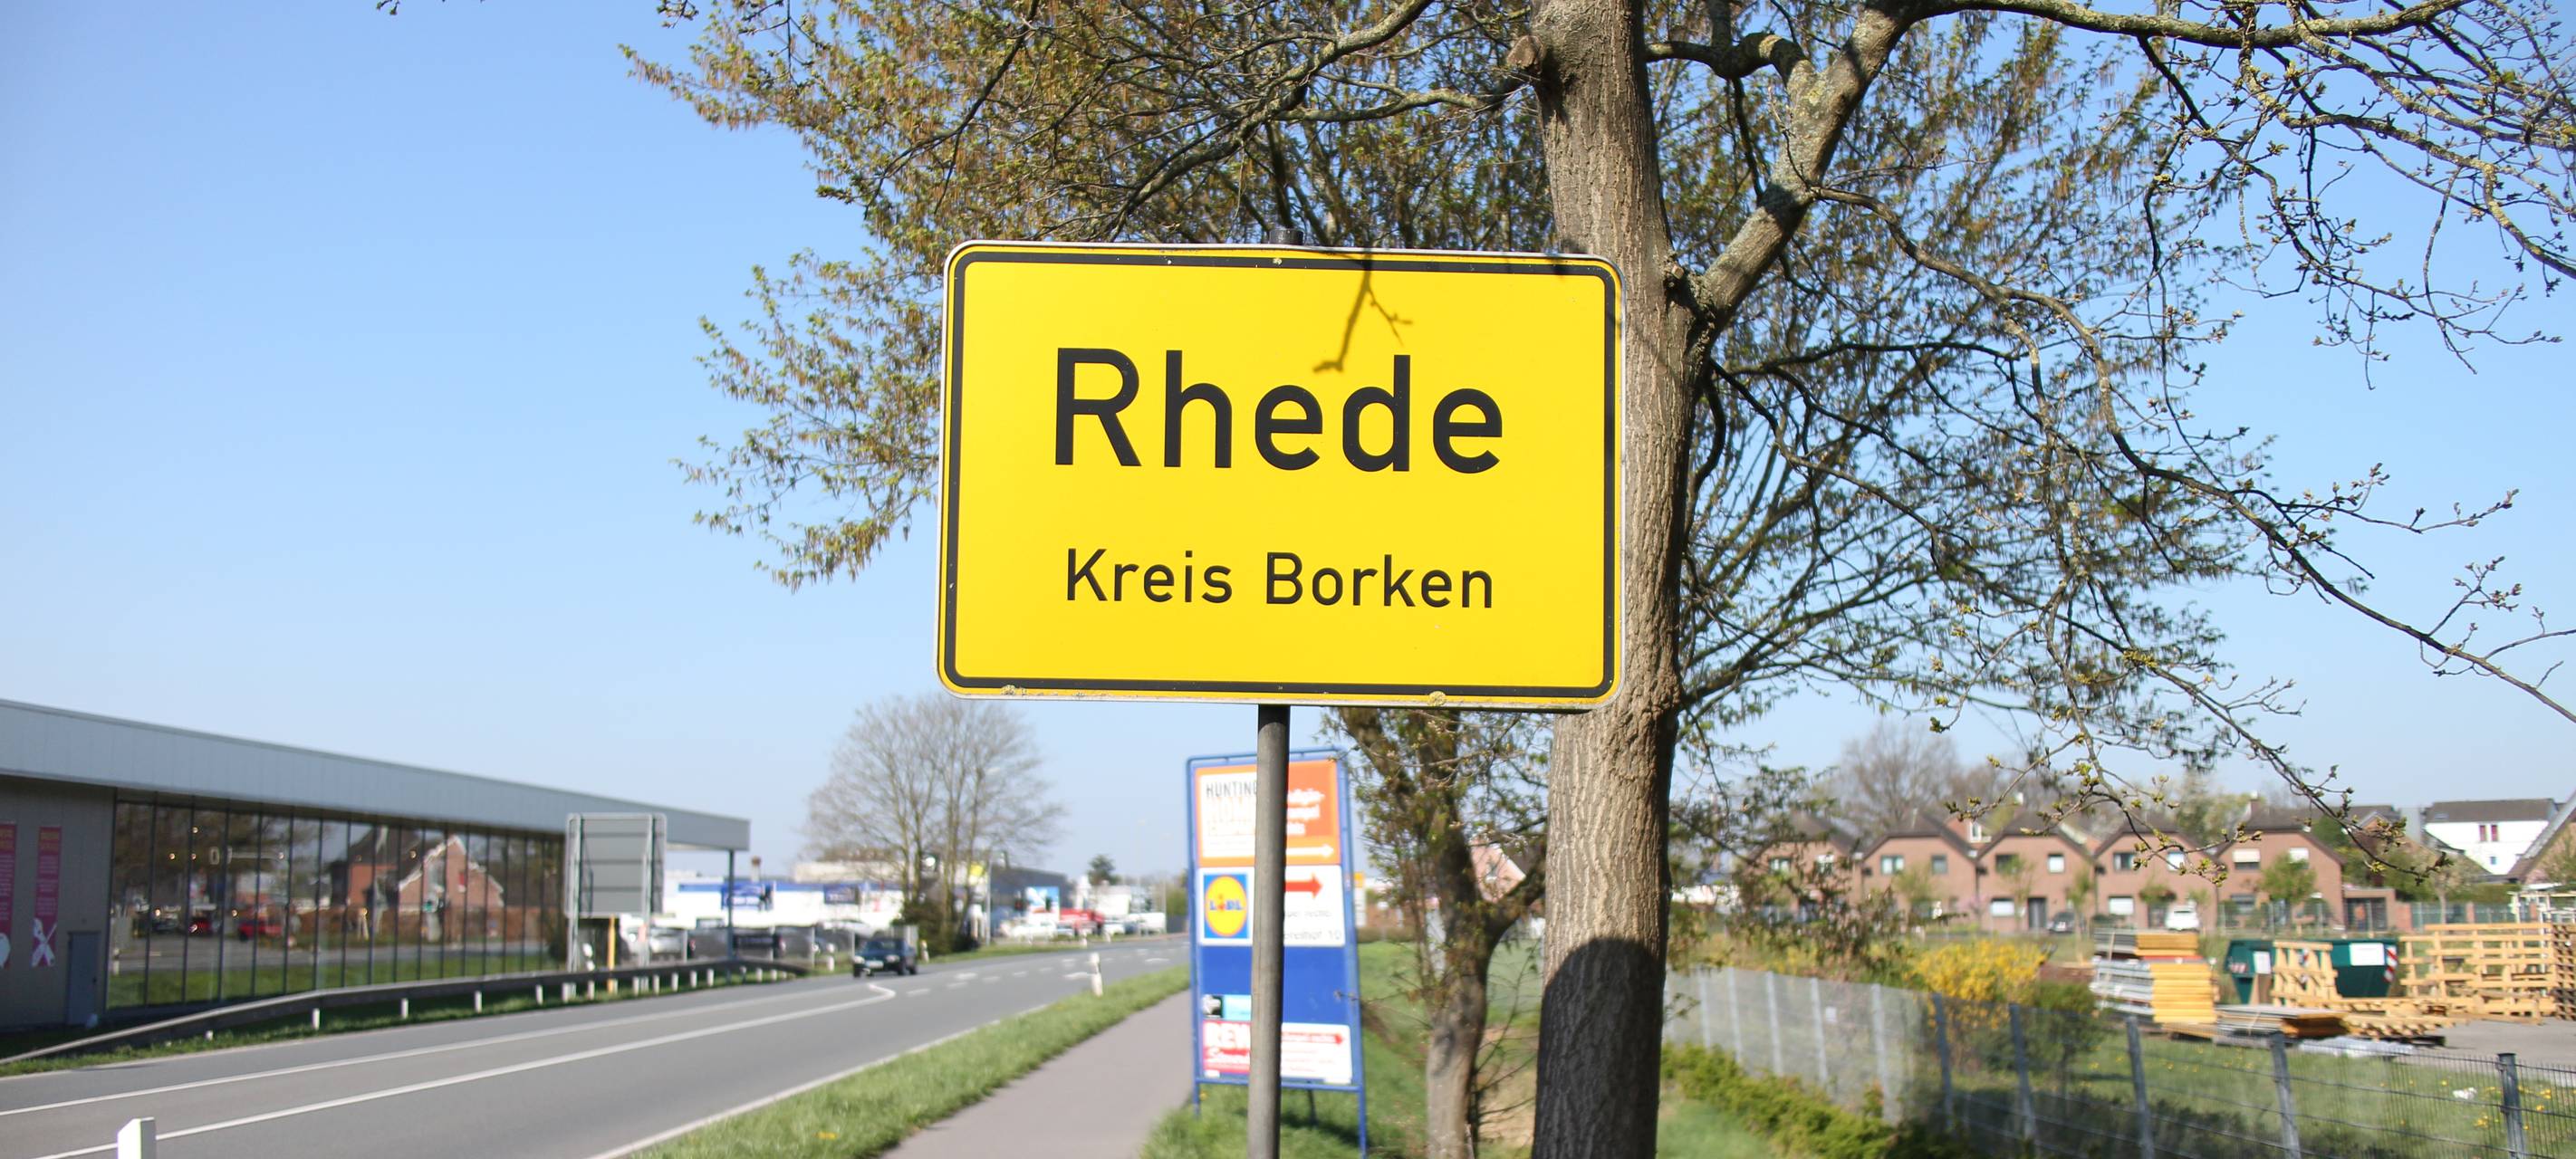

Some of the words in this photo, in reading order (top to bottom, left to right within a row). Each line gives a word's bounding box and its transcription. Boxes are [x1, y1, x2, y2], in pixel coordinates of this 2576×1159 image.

[1054, 346, 1504, 475] Rhede
[1066, 547, 1234, 605] Kreis
[1265, 551, 1493, 609] Borken
